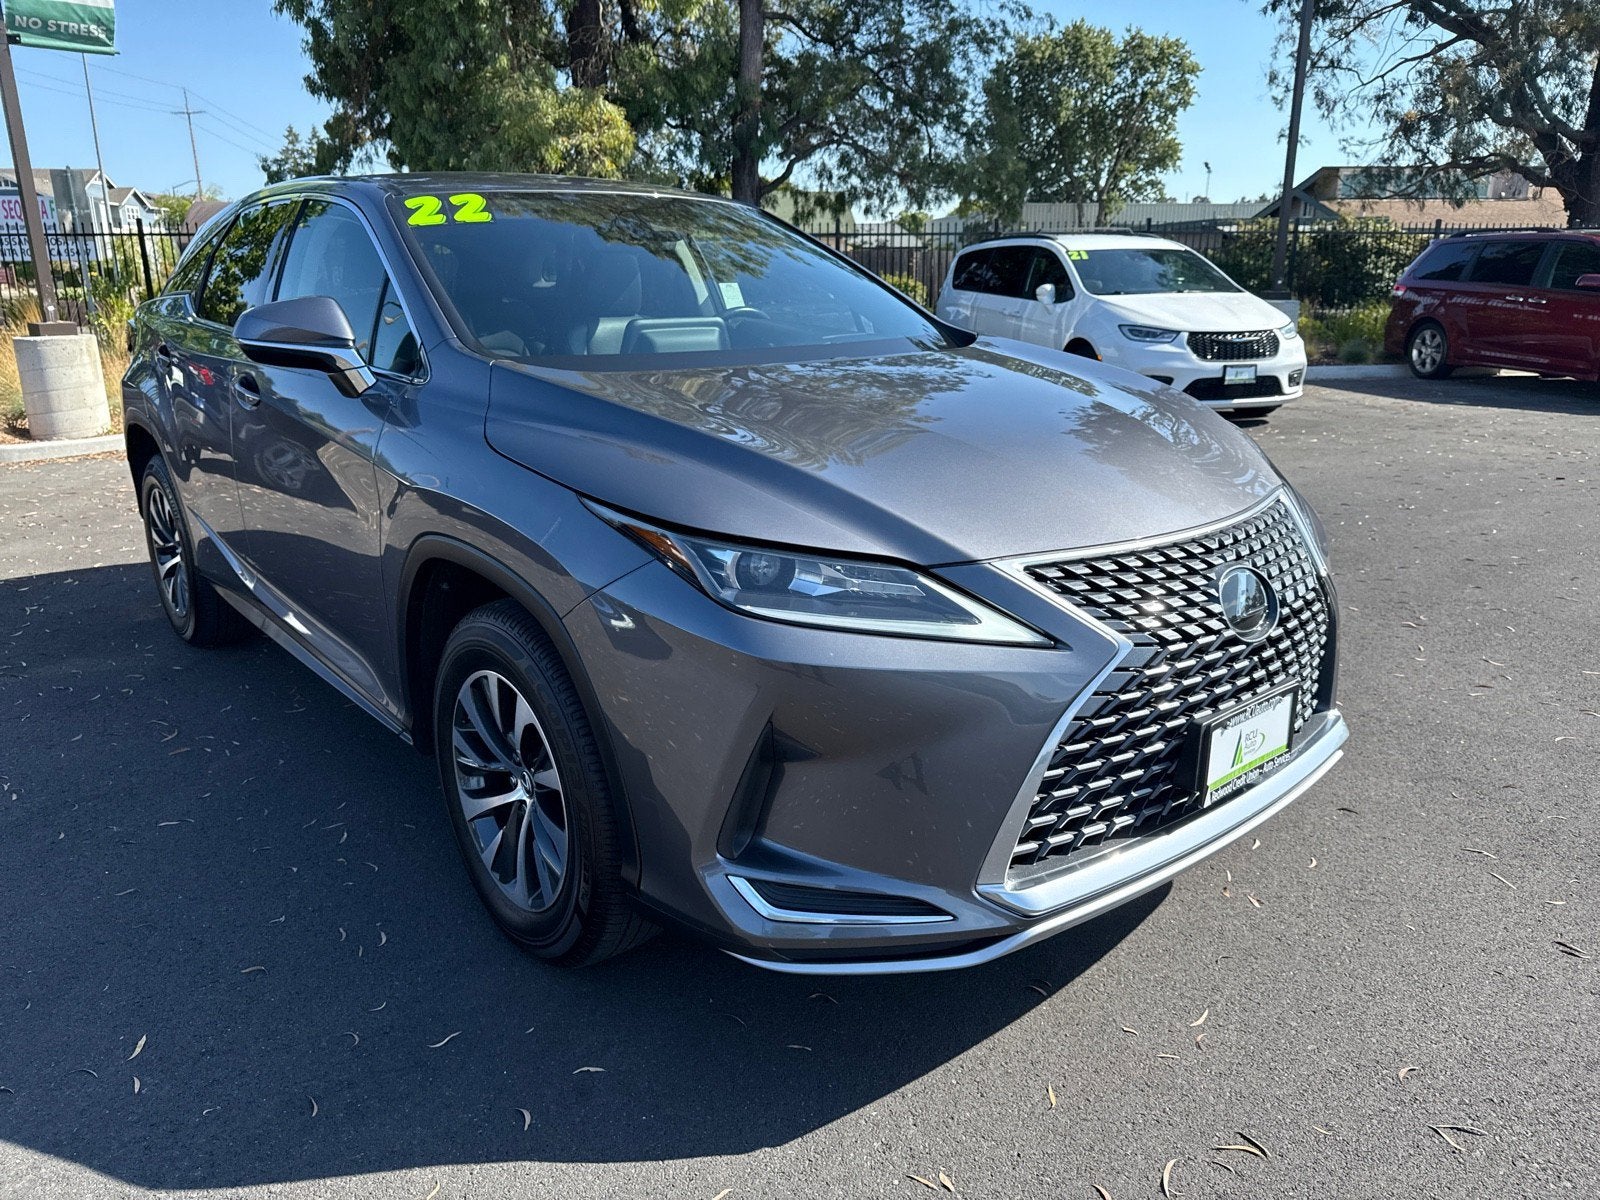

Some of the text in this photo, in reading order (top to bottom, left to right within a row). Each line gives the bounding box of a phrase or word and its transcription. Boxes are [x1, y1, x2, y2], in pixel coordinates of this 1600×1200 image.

[14, 15, 107, 38] NO STRESS
[404, 193, 492, 226] 22
[1068, 250, 1089, 260] 21
[1245, 729, 1258, 742] RCU
[1233, 774, 1246, 790] Credit
[1246, 767, 1260, 783] Union
[1273, 752, 1291, 768] Services
